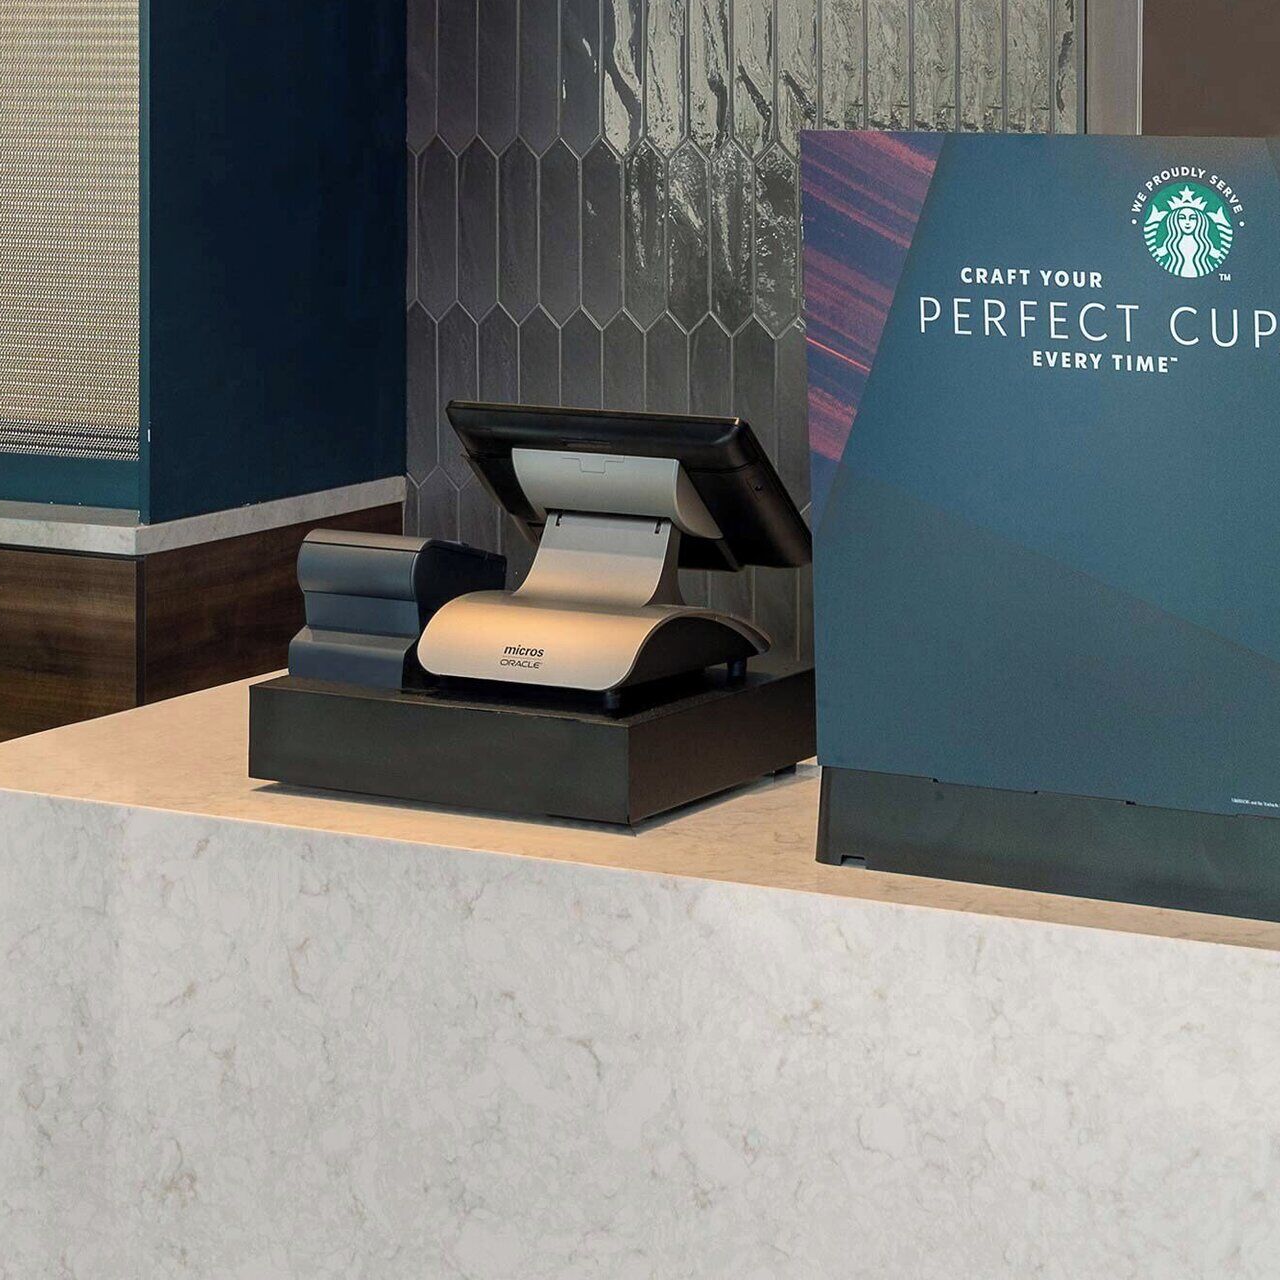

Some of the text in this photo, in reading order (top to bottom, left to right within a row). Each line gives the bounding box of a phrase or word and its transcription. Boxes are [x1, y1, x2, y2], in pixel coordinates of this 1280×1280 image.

[1131, 166, 1244, 214] WE PROUDLY SERVE
[961, 268, 1102, 288] CRAFT YOUR
[920, 297, 1139, 342] PERFECT
[1033, 351, 1102, 369] EVERY
[504, 644, 545, 657] micros
[500, 659, 540, 669] ORACLE
